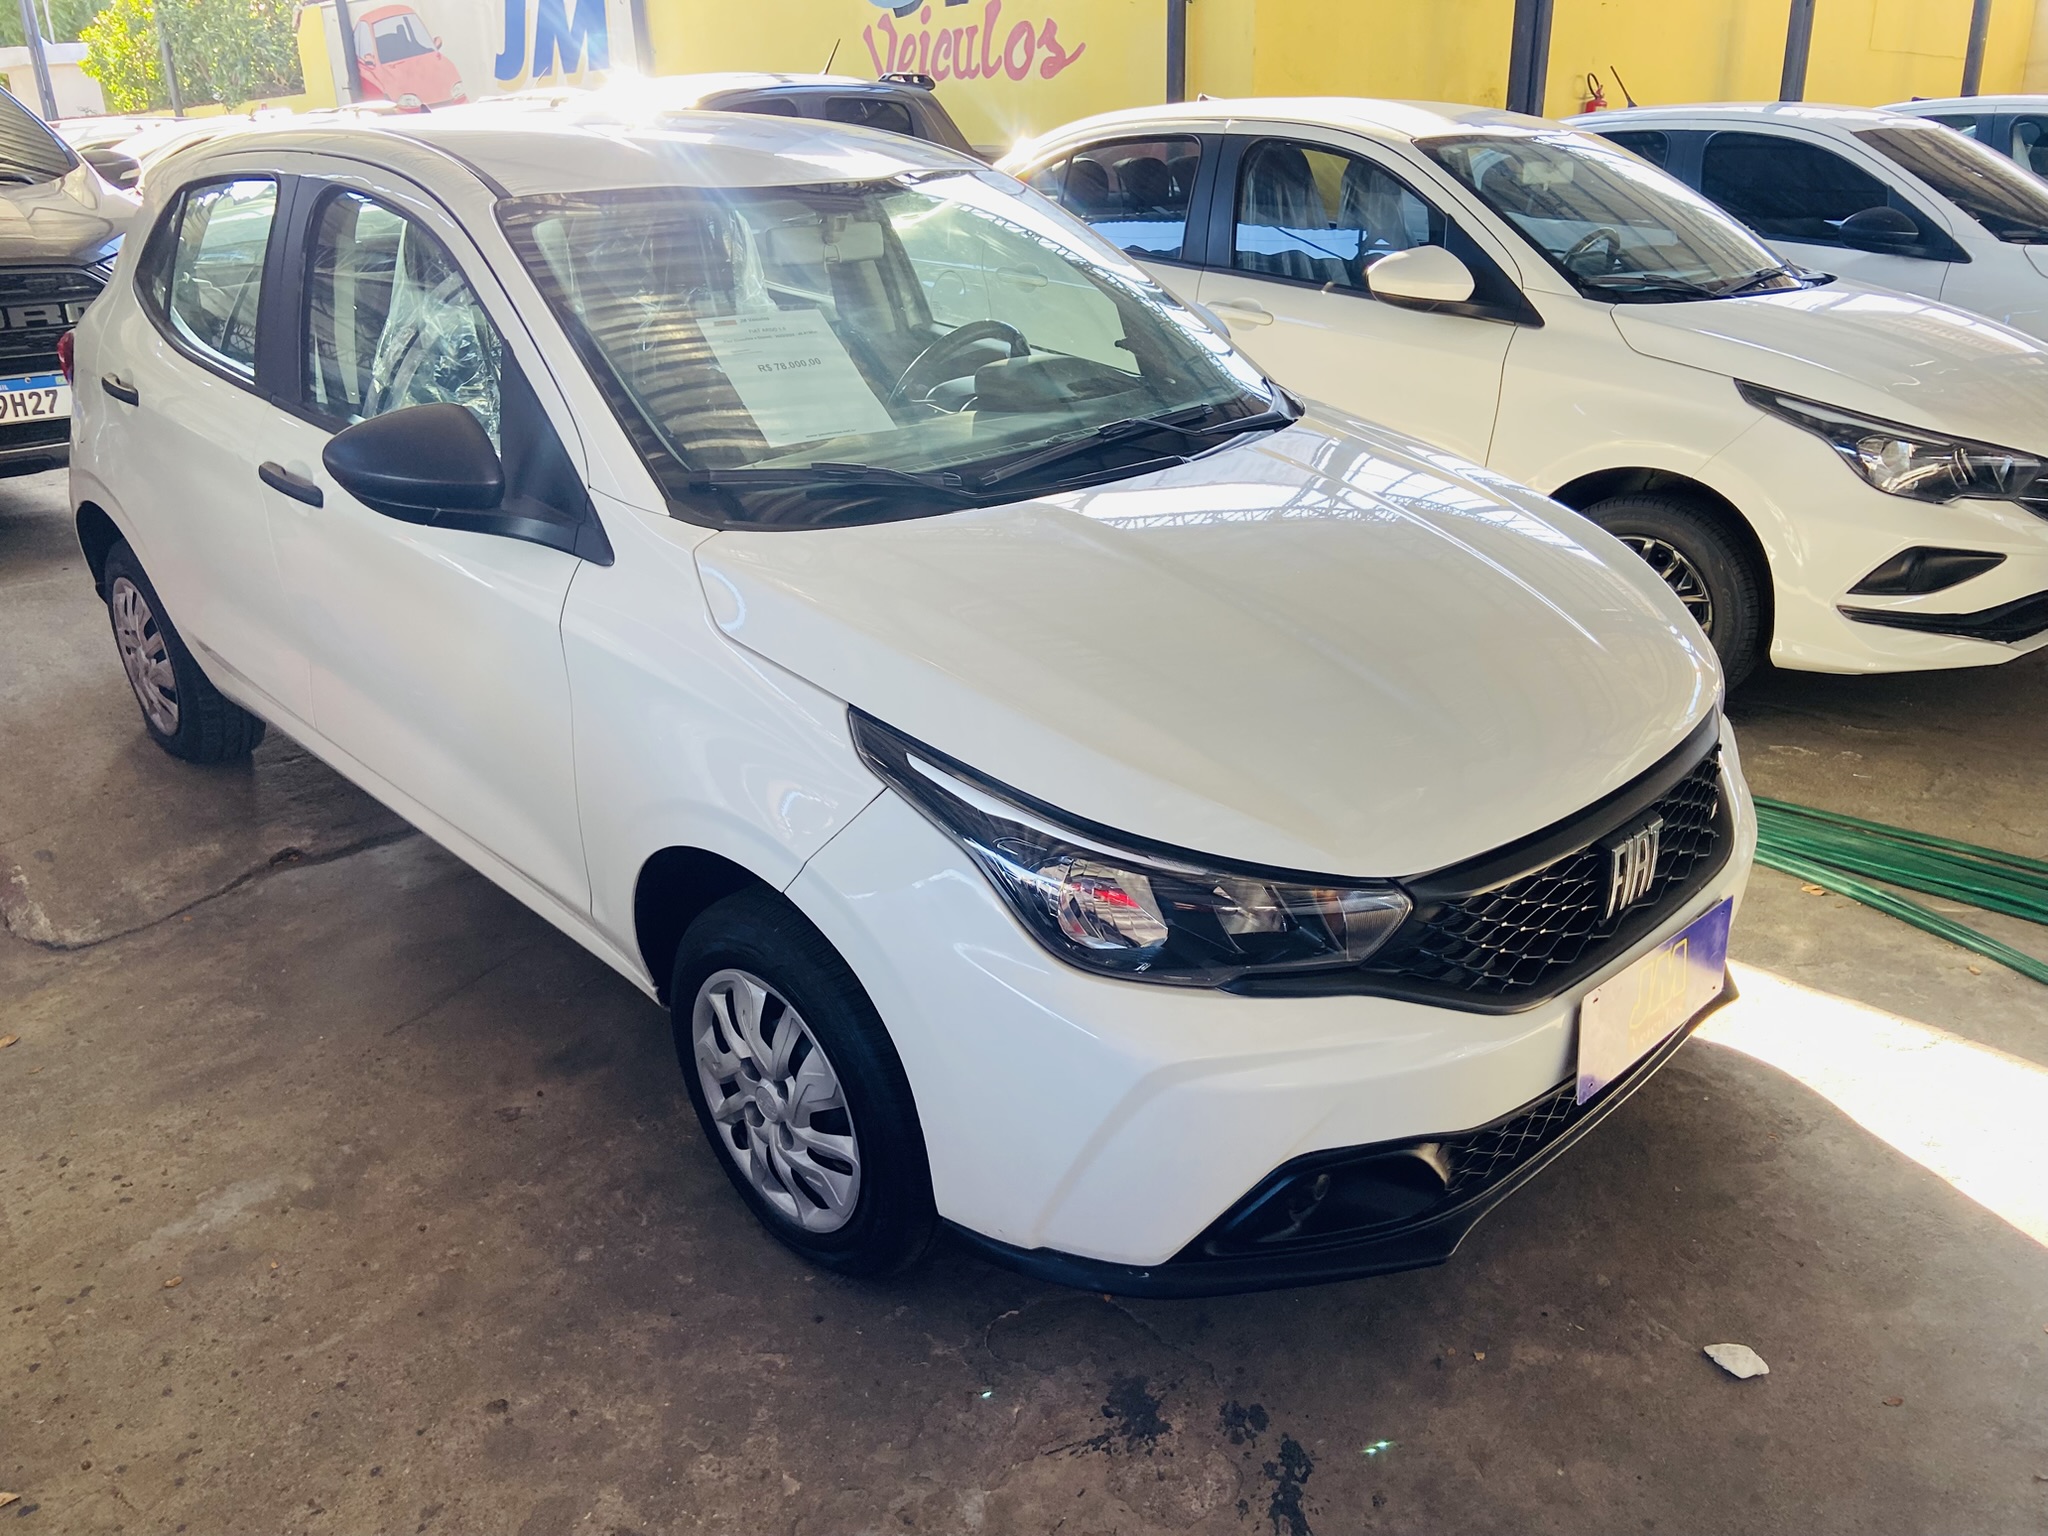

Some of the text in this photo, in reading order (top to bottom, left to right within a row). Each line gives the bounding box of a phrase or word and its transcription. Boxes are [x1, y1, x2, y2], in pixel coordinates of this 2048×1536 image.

[757, 357, 822, 373] R$ 78.000,00
[1606, 818, 1664, 920] FIAT
